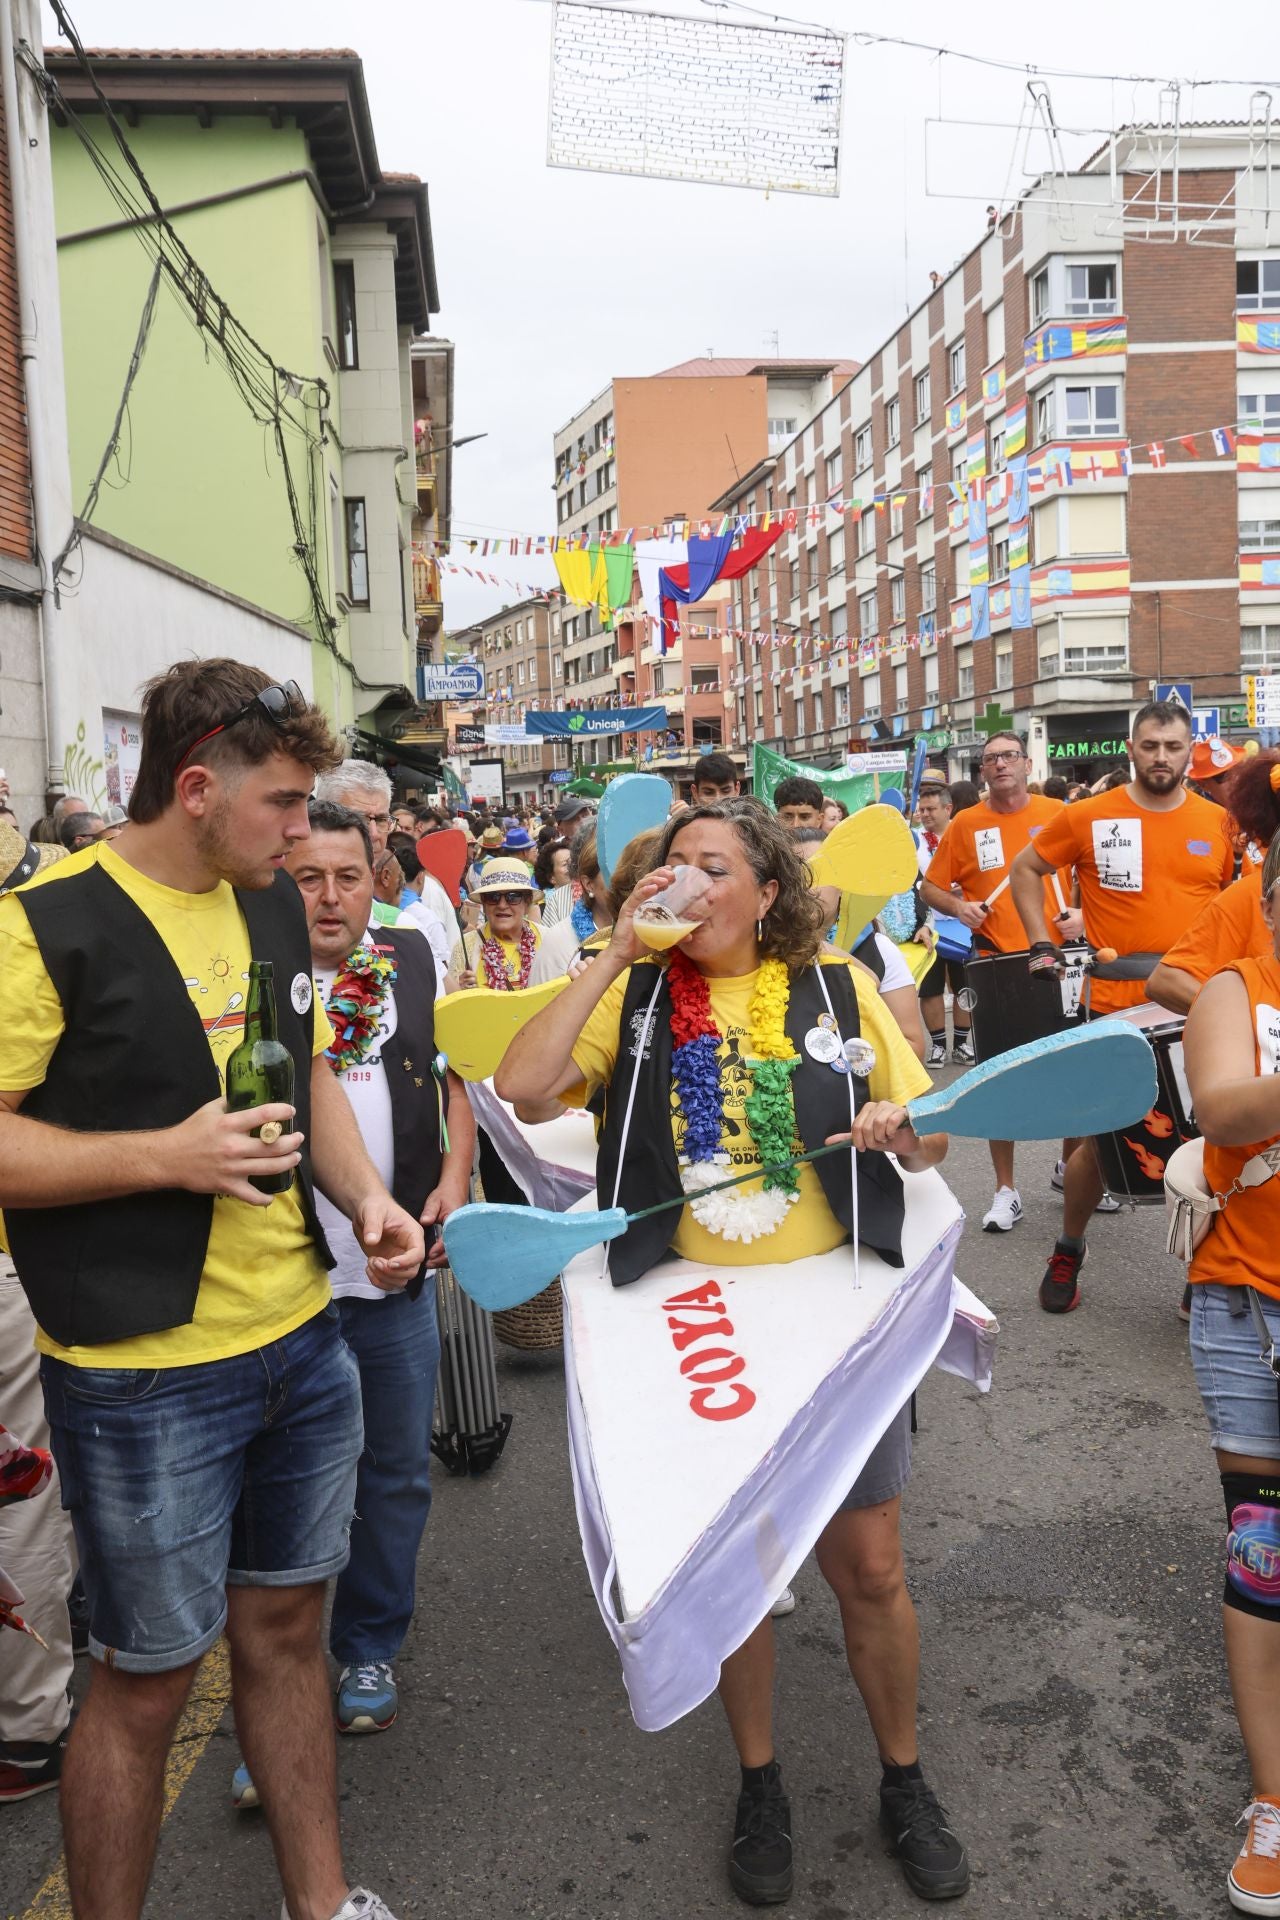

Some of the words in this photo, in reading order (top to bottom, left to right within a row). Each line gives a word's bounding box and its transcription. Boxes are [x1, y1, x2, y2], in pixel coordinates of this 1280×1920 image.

[587, 718, 625, 731] Unicaja
[1047, 740, 1128, 758] FARMACIA
[1119, 839, 1131, 847] BAR
[347, 1072, 371, 1081] 1919
[662, 1280, 756, 1421] COYA
